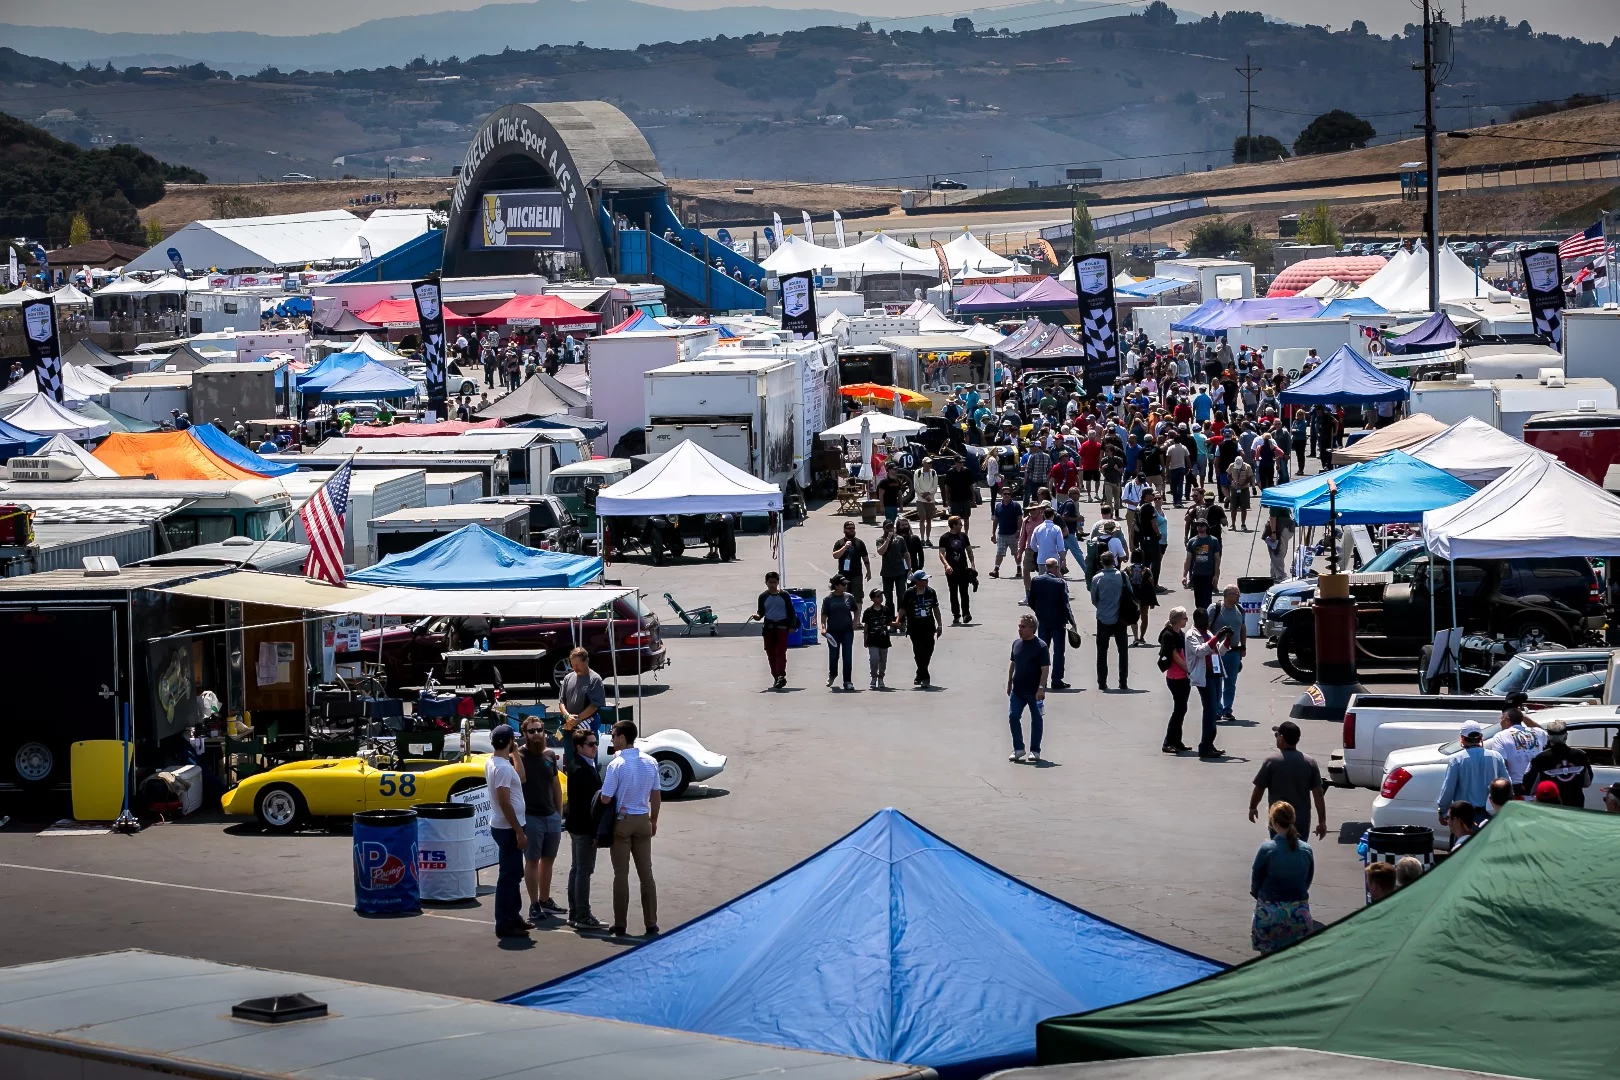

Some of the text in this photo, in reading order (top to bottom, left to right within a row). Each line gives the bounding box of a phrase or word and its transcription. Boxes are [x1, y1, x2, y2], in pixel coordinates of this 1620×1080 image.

[454, 123, 495, 214] MICHELIN
[498, 117, 519, 144] Pilot
[520, 119, 547, 160] Sport
[506, 206, 562, 228] MICHELIN
[937, 355, 969, 367] AUTO
[902, 454, 914, 469] 19
[379, 773, 416, 797] 58
[354, 841, 388, 891] VP
[372, 864, 406, 880] Racing
